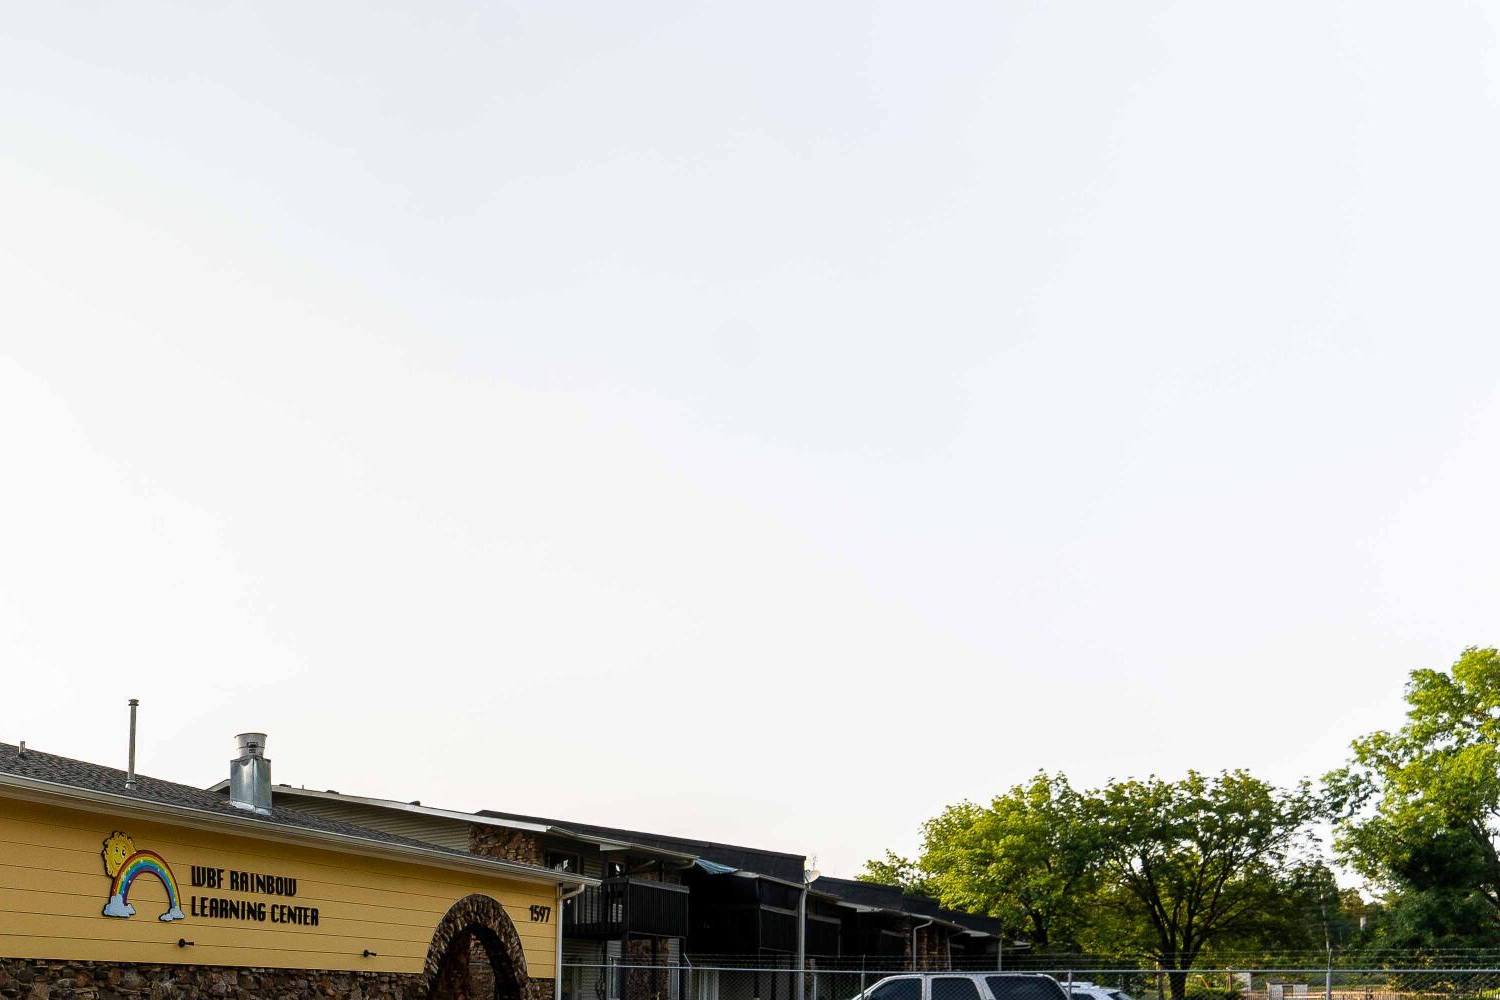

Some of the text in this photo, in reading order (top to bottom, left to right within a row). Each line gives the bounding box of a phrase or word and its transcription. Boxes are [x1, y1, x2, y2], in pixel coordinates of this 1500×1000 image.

[191, 865, 297, 897] WBF RAINBOW
[190, 896, 319, 927] LEARNING CENTER
[529, 905, 551, 923] 1597
